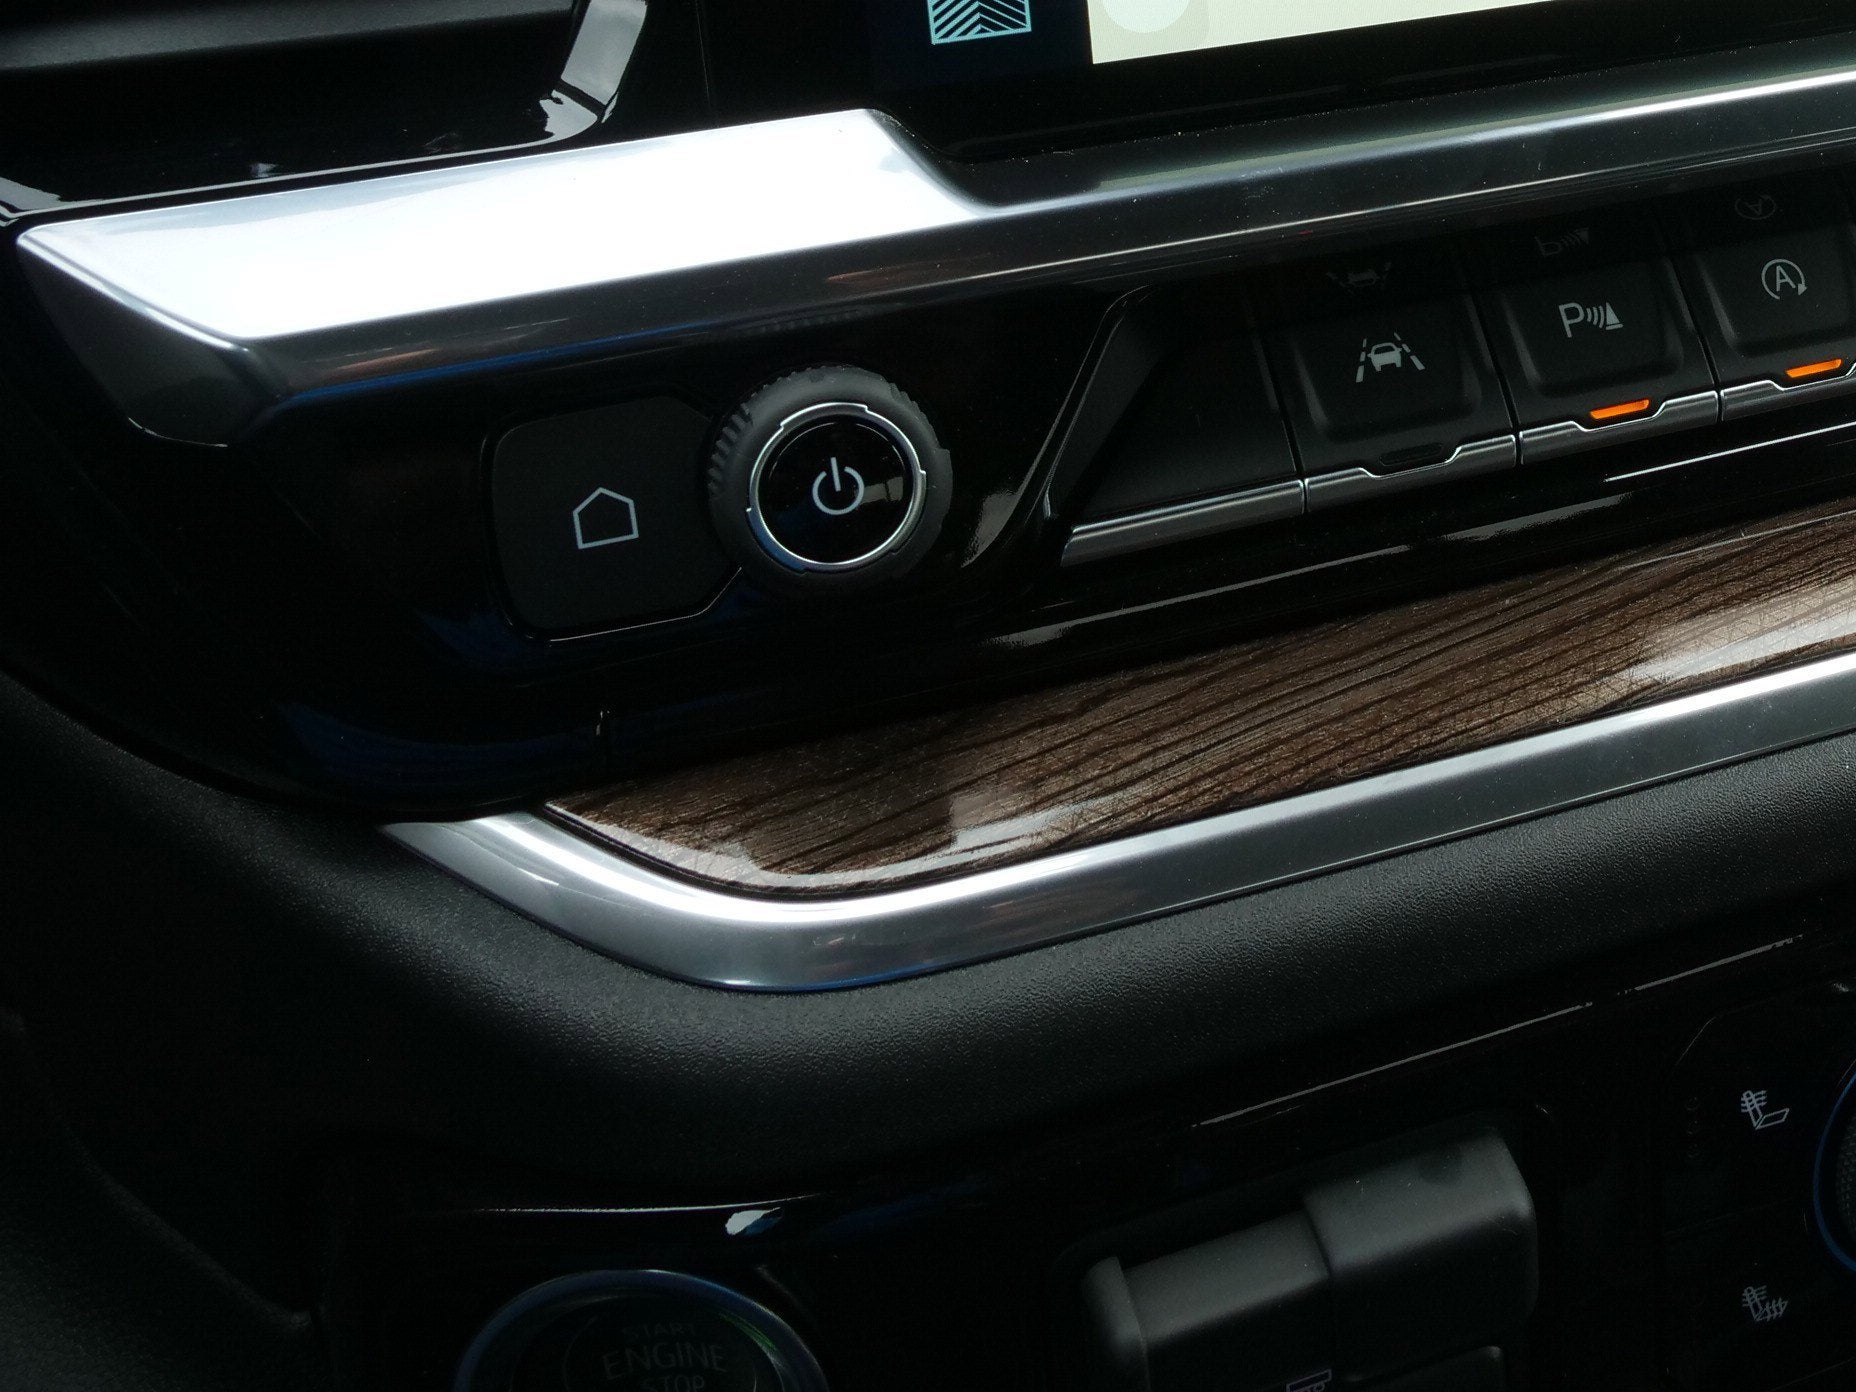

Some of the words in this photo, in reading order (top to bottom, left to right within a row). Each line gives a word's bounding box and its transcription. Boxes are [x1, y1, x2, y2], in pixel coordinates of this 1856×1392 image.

[1774, 266, 1795, 291] A
[1558, 301, 1585, 338] P
[601, 1340, 728, 1381] ENGINE
